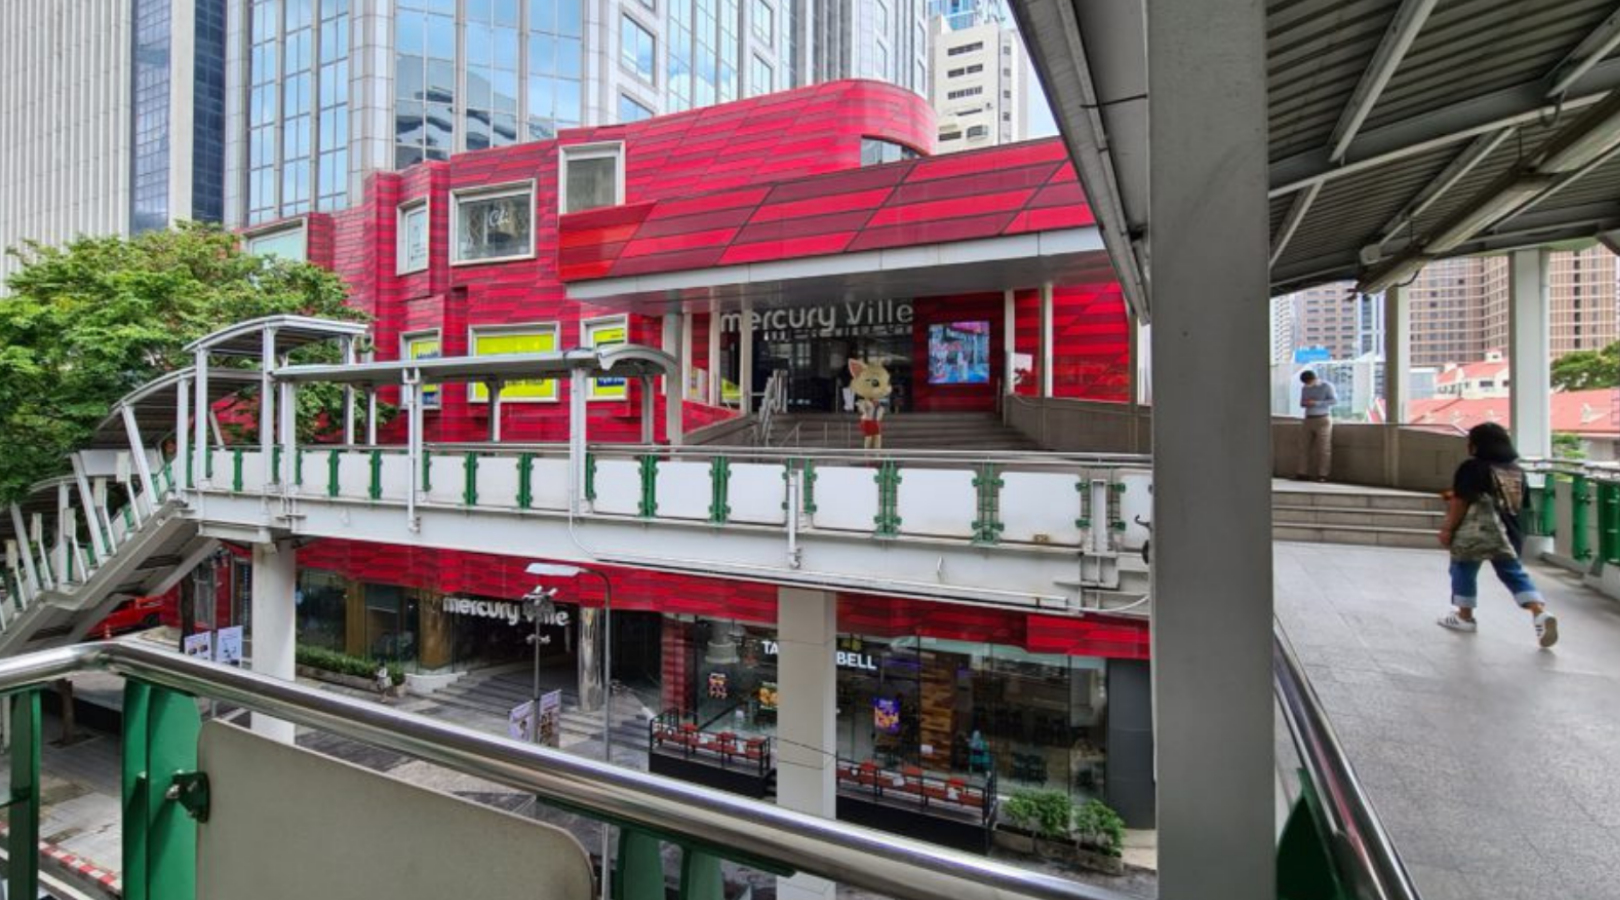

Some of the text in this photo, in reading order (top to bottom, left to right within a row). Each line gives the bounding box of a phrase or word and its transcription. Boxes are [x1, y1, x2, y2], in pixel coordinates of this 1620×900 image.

[721, 299, 914, 332] mercury Ville
[443, 597, 520, 626] mercury
[836, 650, 878, 670] BELL
